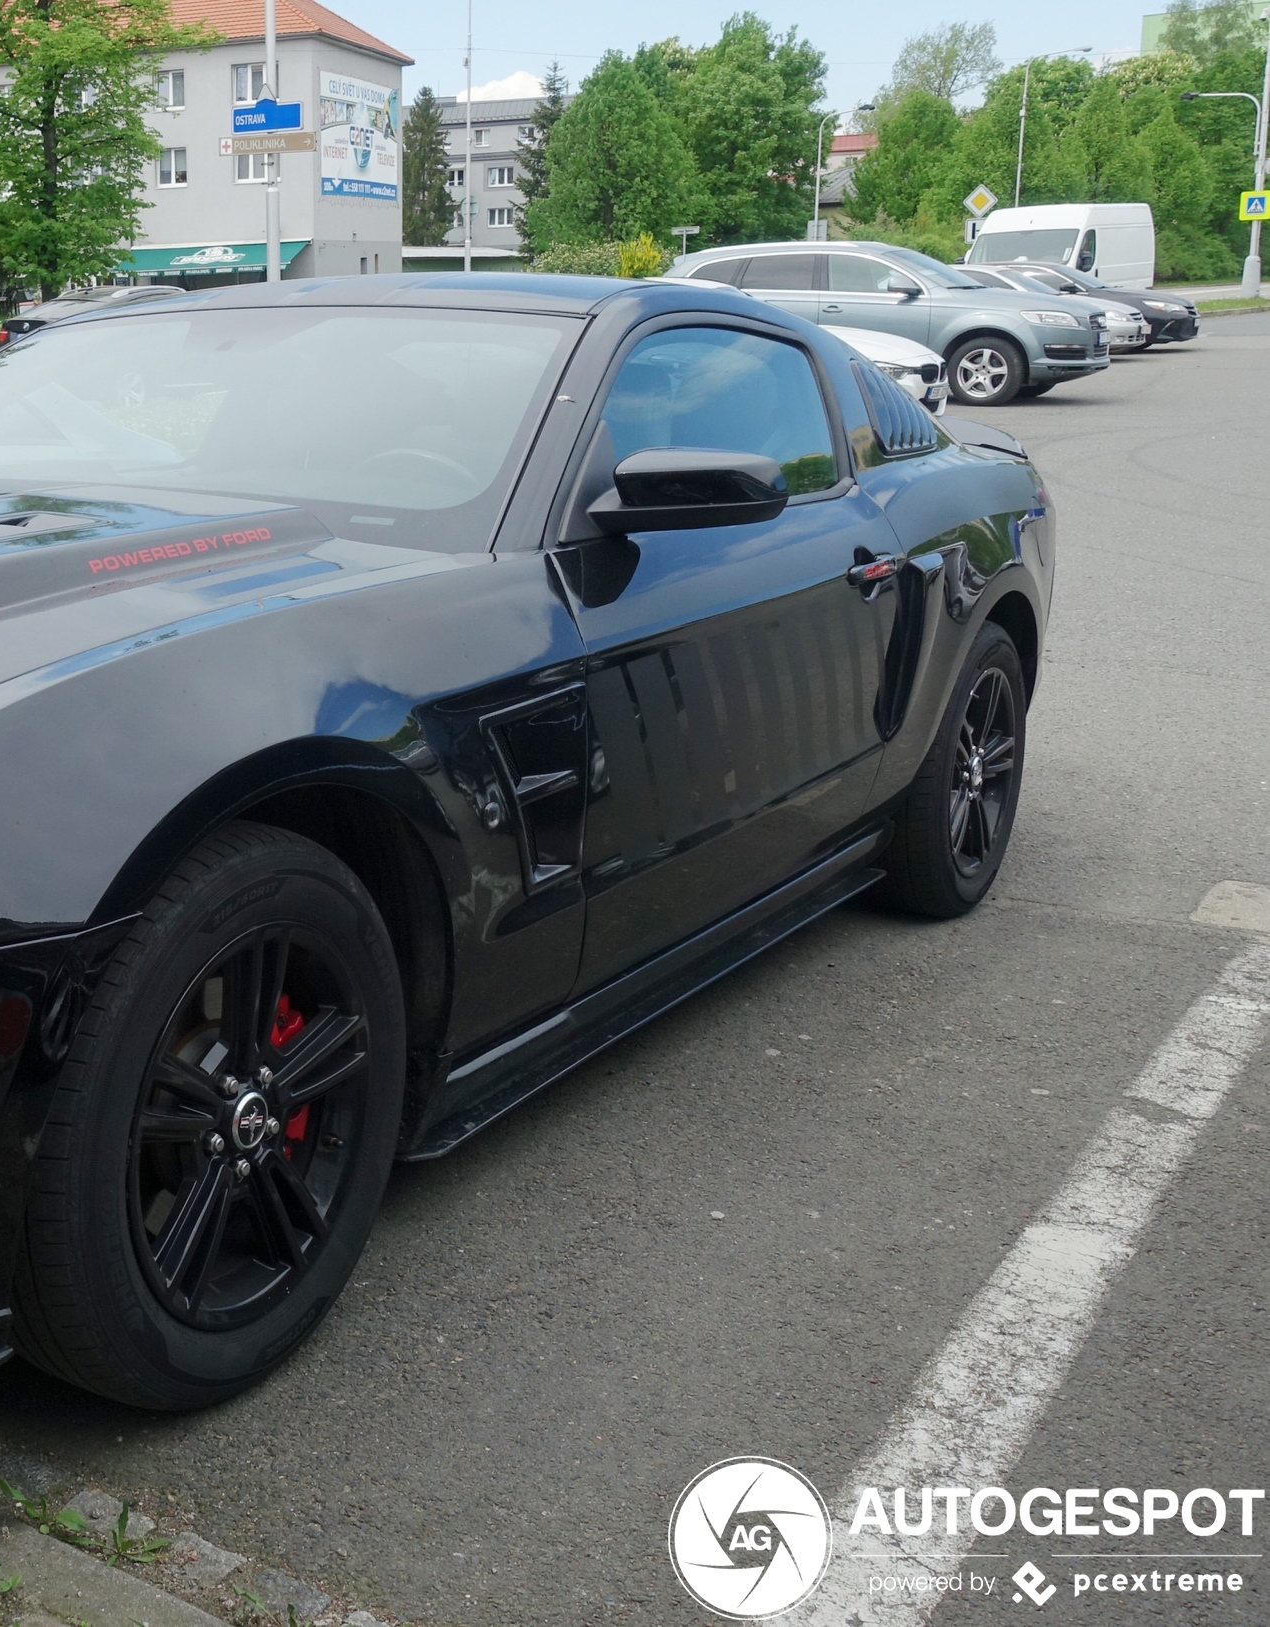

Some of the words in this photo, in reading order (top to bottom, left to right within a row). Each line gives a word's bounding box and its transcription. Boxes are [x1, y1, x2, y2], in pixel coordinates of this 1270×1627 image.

[329, 79, 341, 94] CELÝ
[342, 81, 355, 97] SVĚT
[360, 85, 371, 100] VÁS
[371, 90, 386, 104] DOMA
[235, 113, 266, 126] OSTRAVA
[234, 138, 286, 150] POLIKLINIKA
[323, 145, 348, 160] INTERNET
[377, 153, 395, 167] TELEVIZE
[88, 542, 192, 574] POWERED
[192, 536, 220, 553] BY
[221, 527, 272, 547] FORD
[265, 1308, 315, 1361] OUTSIDE
